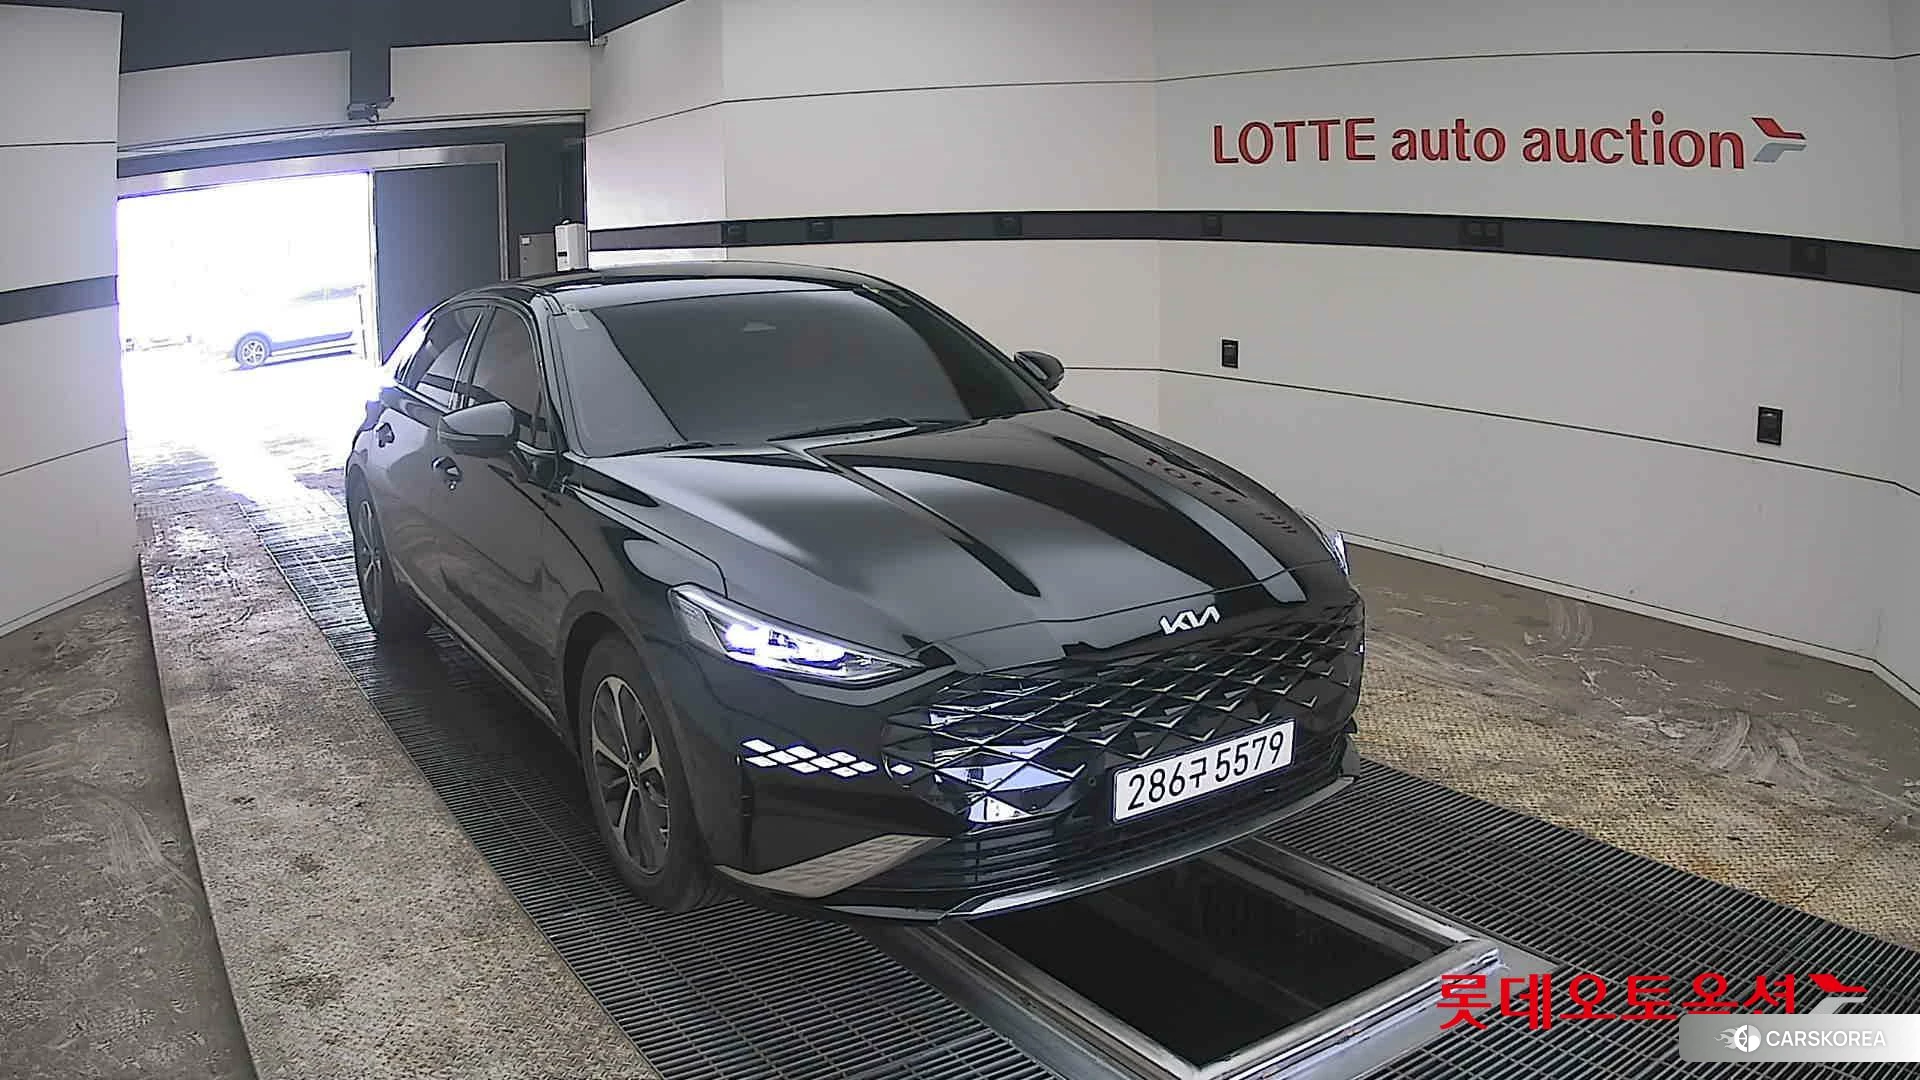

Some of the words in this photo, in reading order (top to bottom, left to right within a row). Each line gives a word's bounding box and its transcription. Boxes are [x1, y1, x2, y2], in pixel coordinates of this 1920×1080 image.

[1213, 116, 1376, 164] LOTTE
[1391, 117, 1506, 162] auto
[1522, 110, 1745, 170] auction
[1159, 606, 1221, 635] KIA
[1215, 730, 1285, 783] 5579
